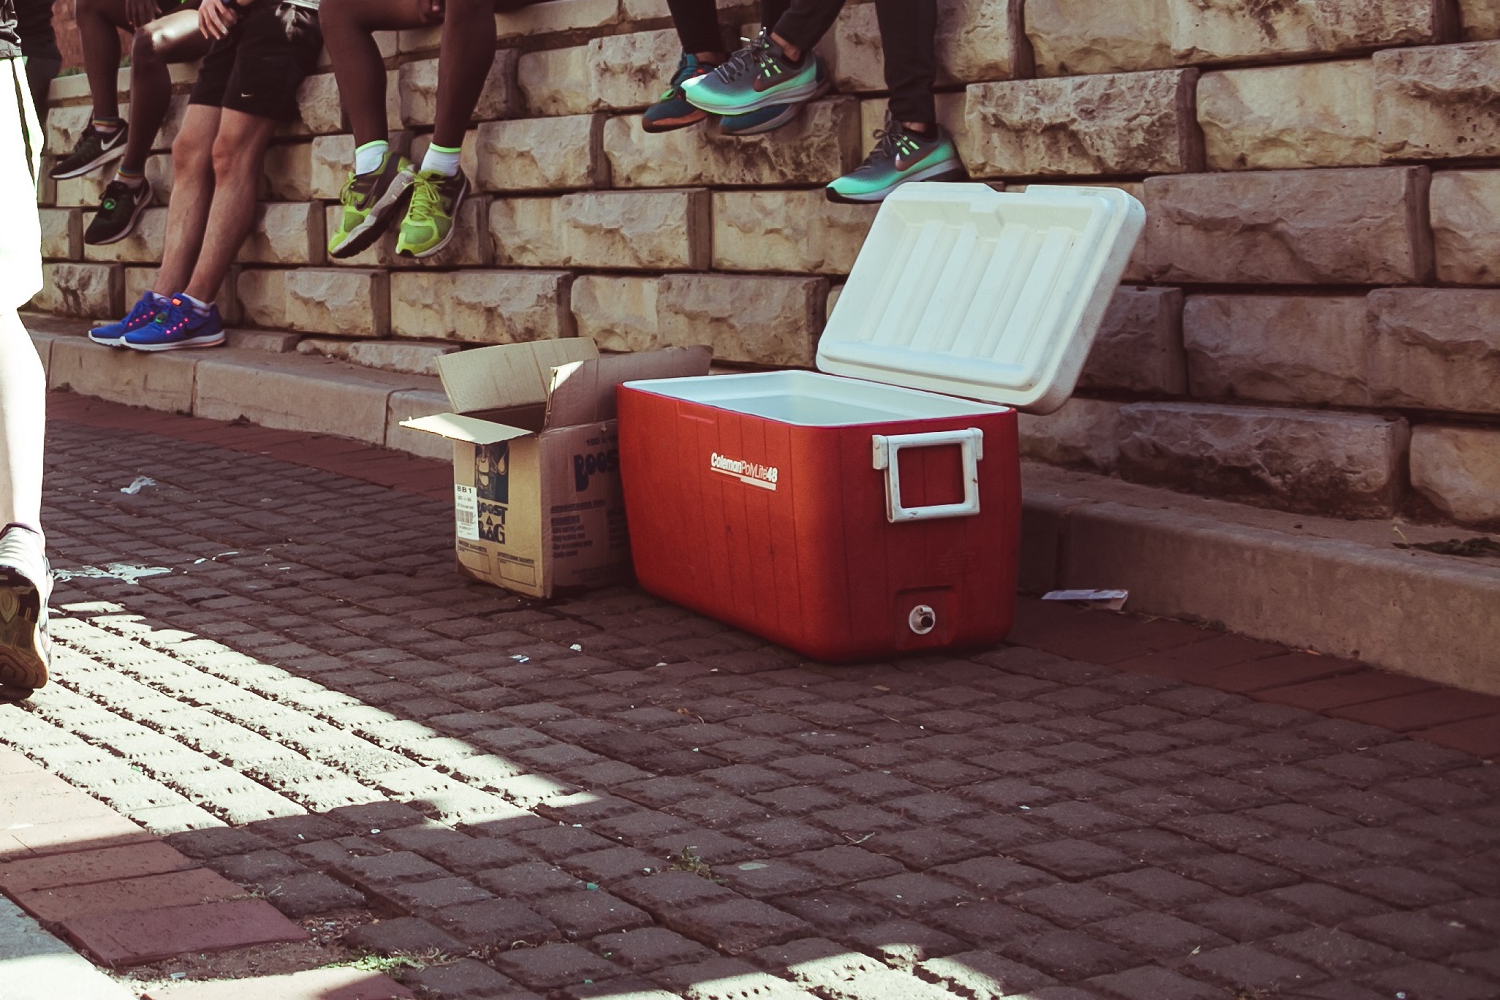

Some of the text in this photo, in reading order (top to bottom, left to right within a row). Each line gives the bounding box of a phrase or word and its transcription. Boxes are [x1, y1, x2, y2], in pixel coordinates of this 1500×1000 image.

[573, 448, 619, 492] BOOS
[711, 452, 742, 474] Coleman
[766, 466, 778, 483] 48
